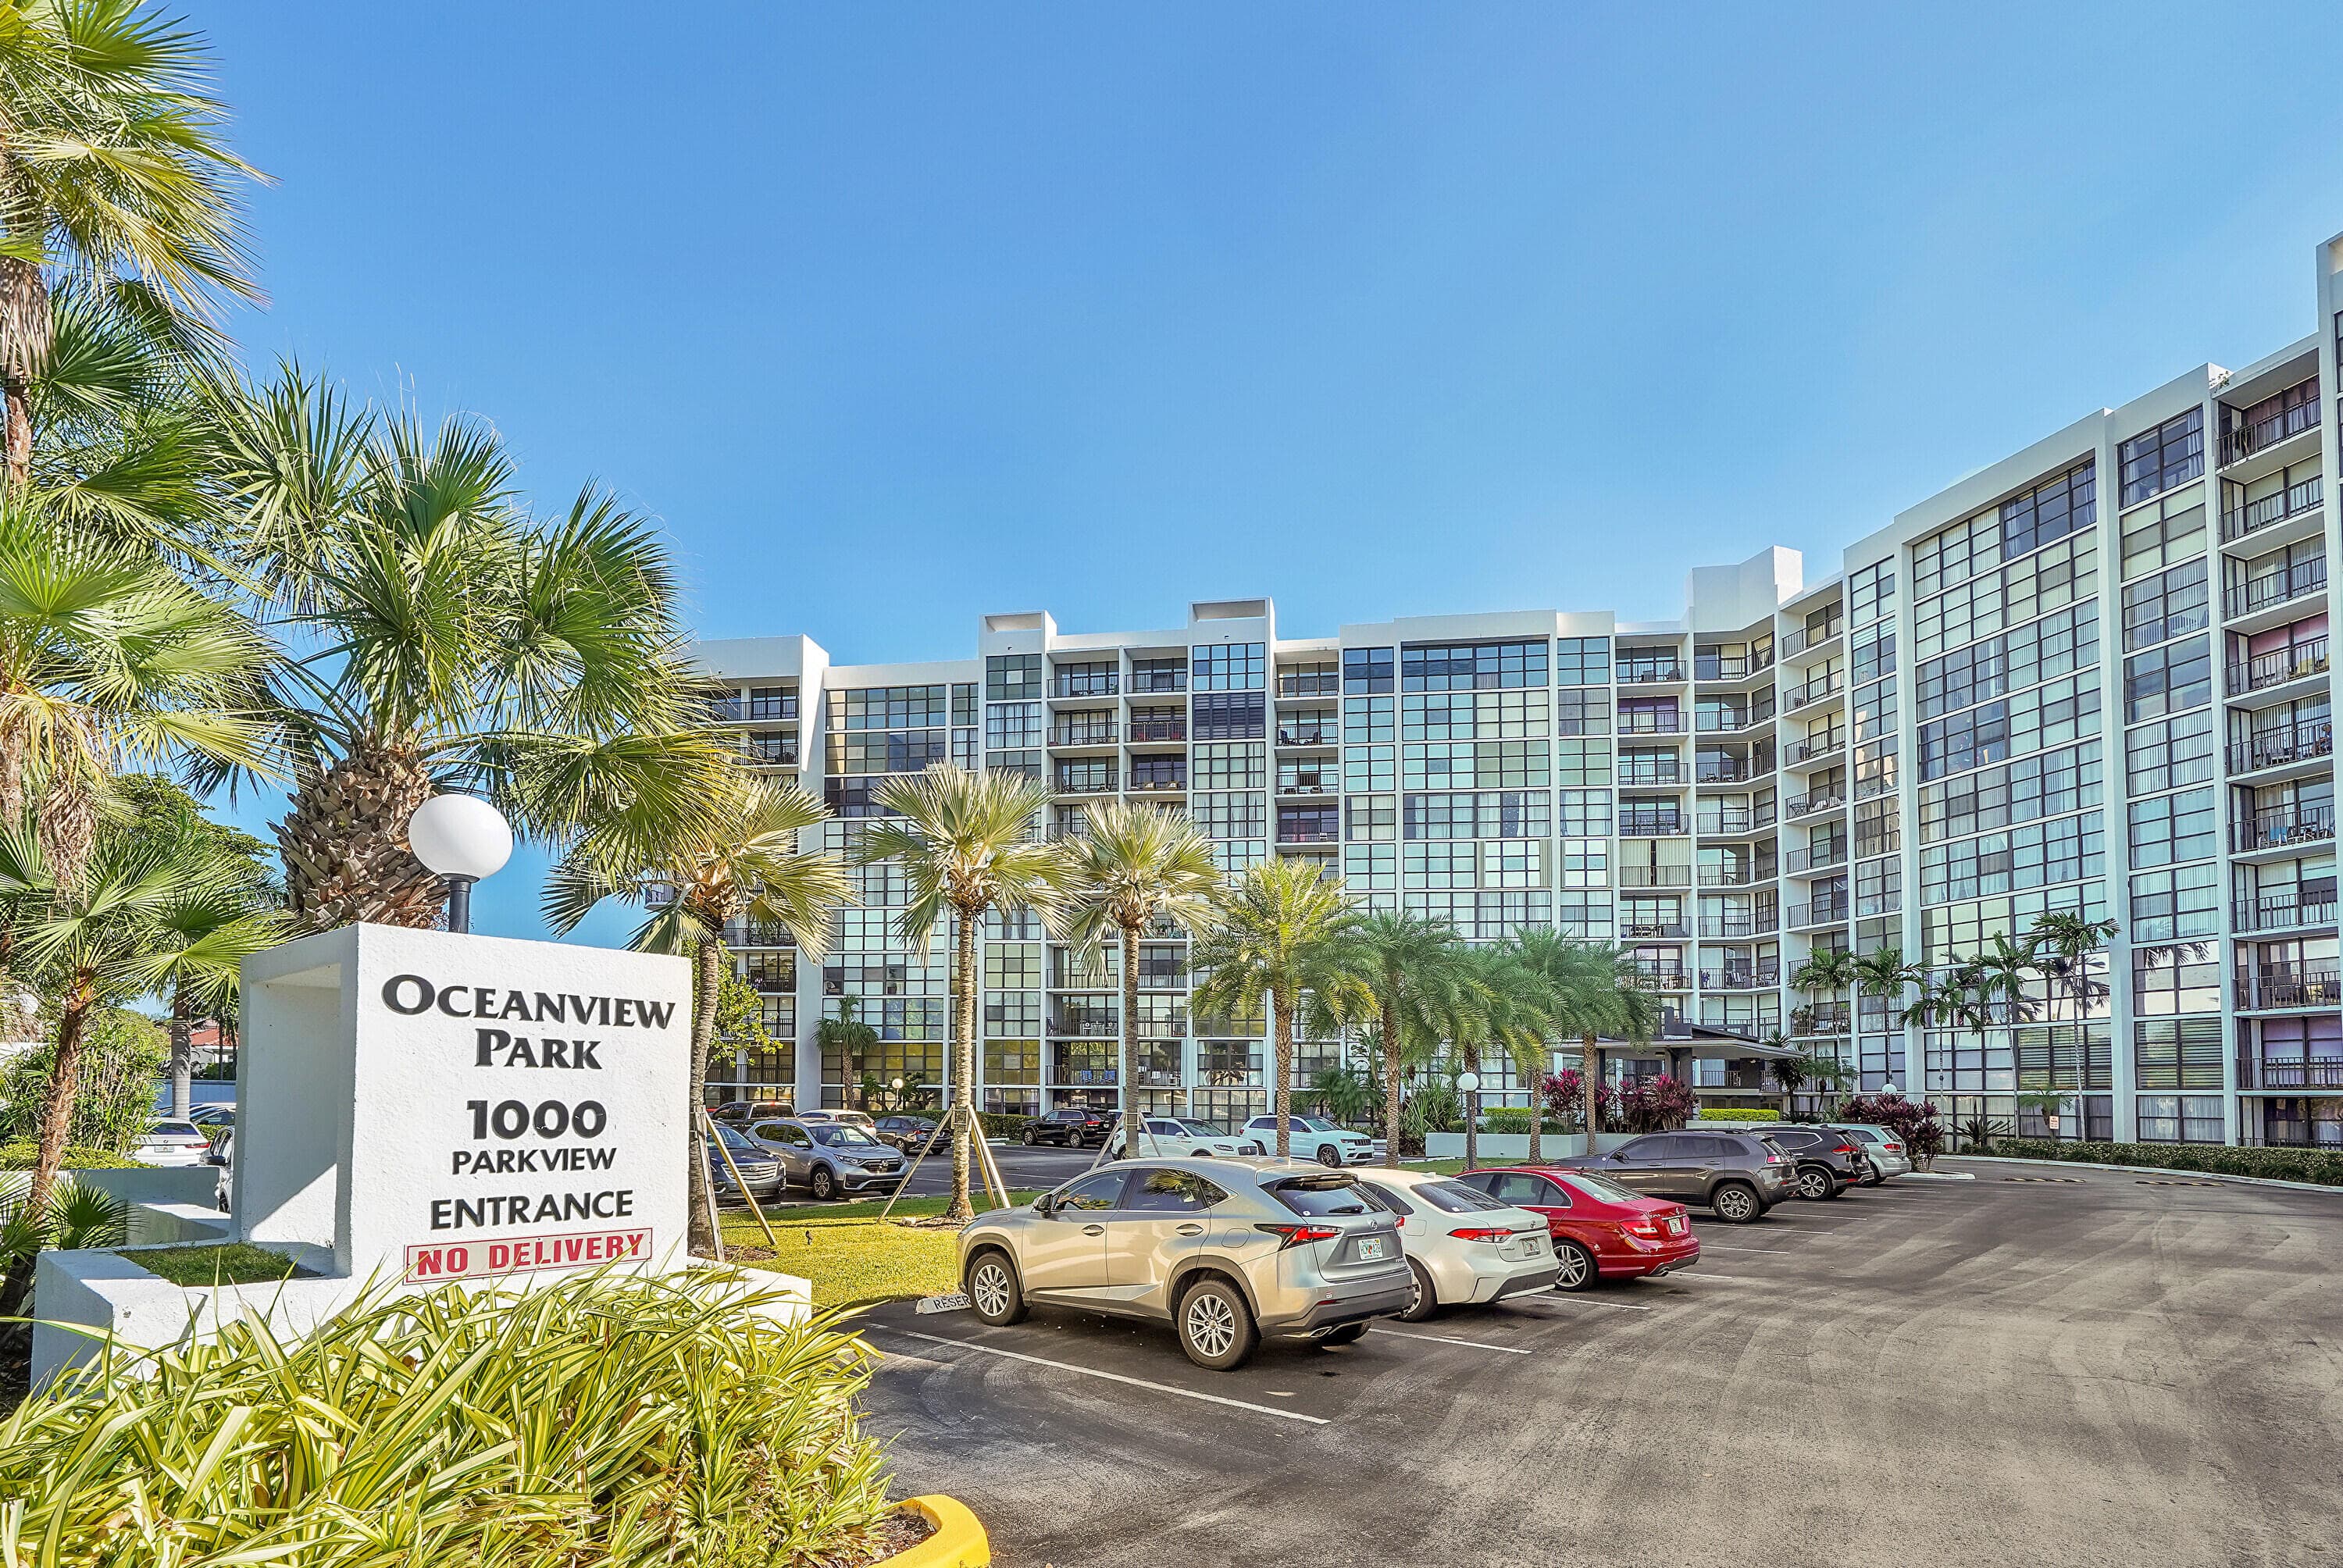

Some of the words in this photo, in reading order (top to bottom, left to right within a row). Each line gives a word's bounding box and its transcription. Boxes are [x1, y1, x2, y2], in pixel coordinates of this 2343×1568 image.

[381, 974, 676, 1030] OCEANVIEW
[473, 1028, 602, 1070] PARK
[467, 1099, 607, 1140] 1000
[452, 1147, 617, 1175] PARKVIEW
[430, 1189, 633, 1230] ENTRANCE
[417, 1247, 469, 1276] NO
[489, 1233, 644, 1270] DELIVERY
